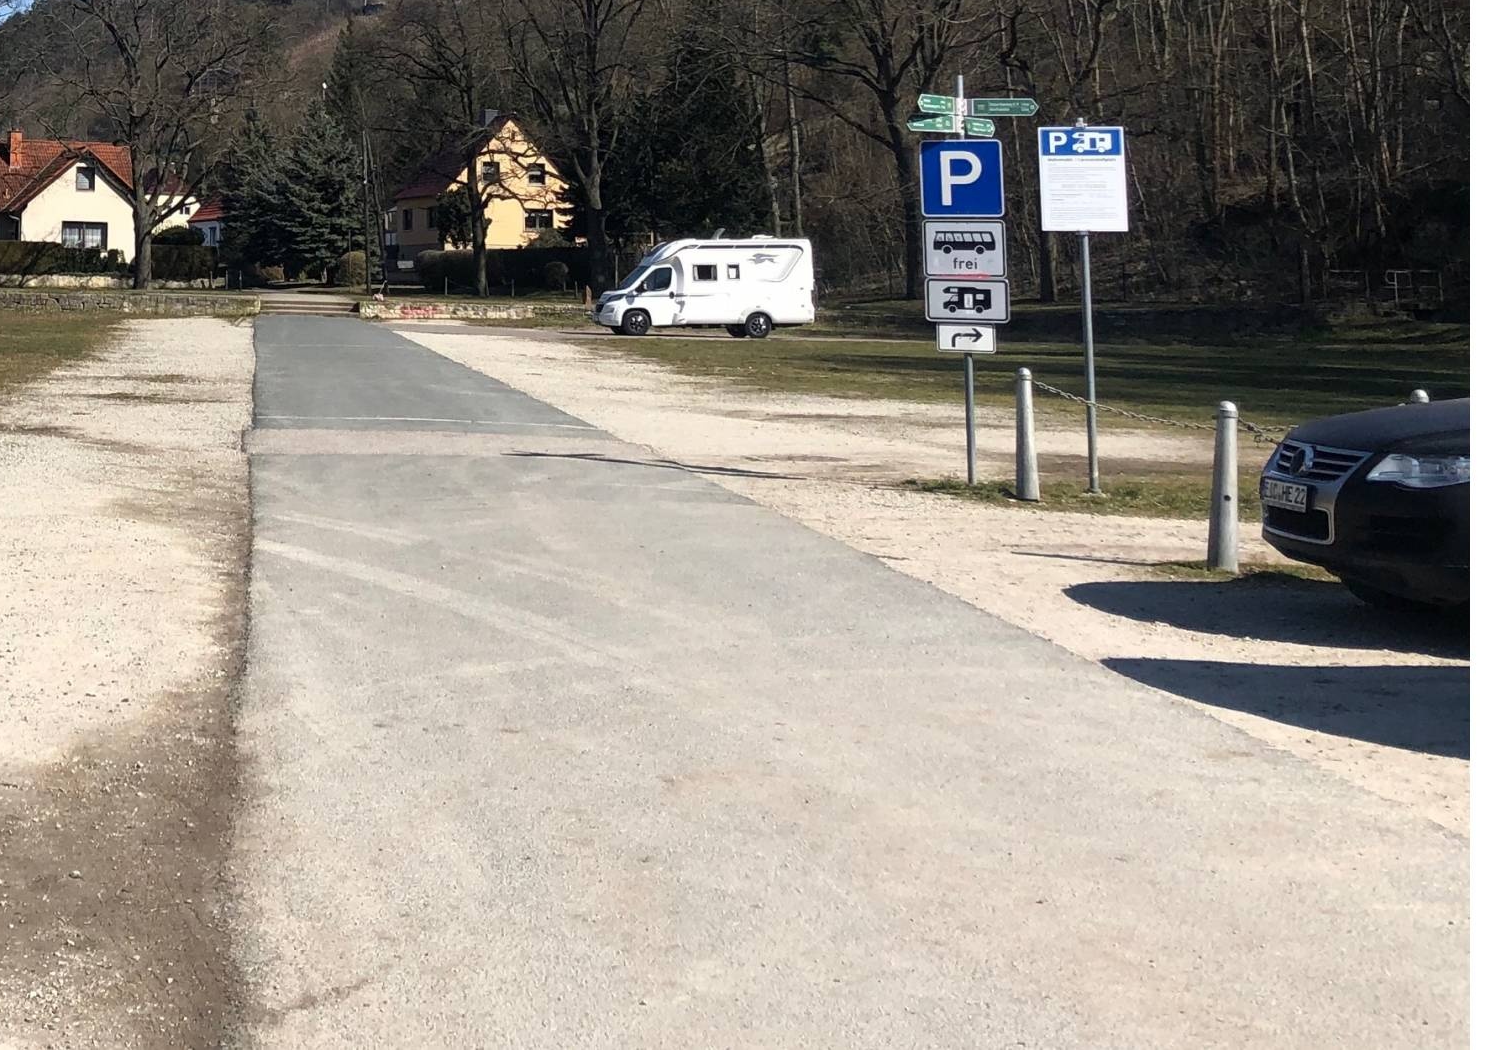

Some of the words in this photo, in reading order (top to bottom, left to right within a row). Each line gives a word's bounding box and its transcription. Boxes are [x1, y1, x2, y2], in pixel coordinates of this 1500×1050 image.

[1048, 132, 1068, 153] P
[940, 151, 982, 206] P
[953, 258, 978, 270] frei
